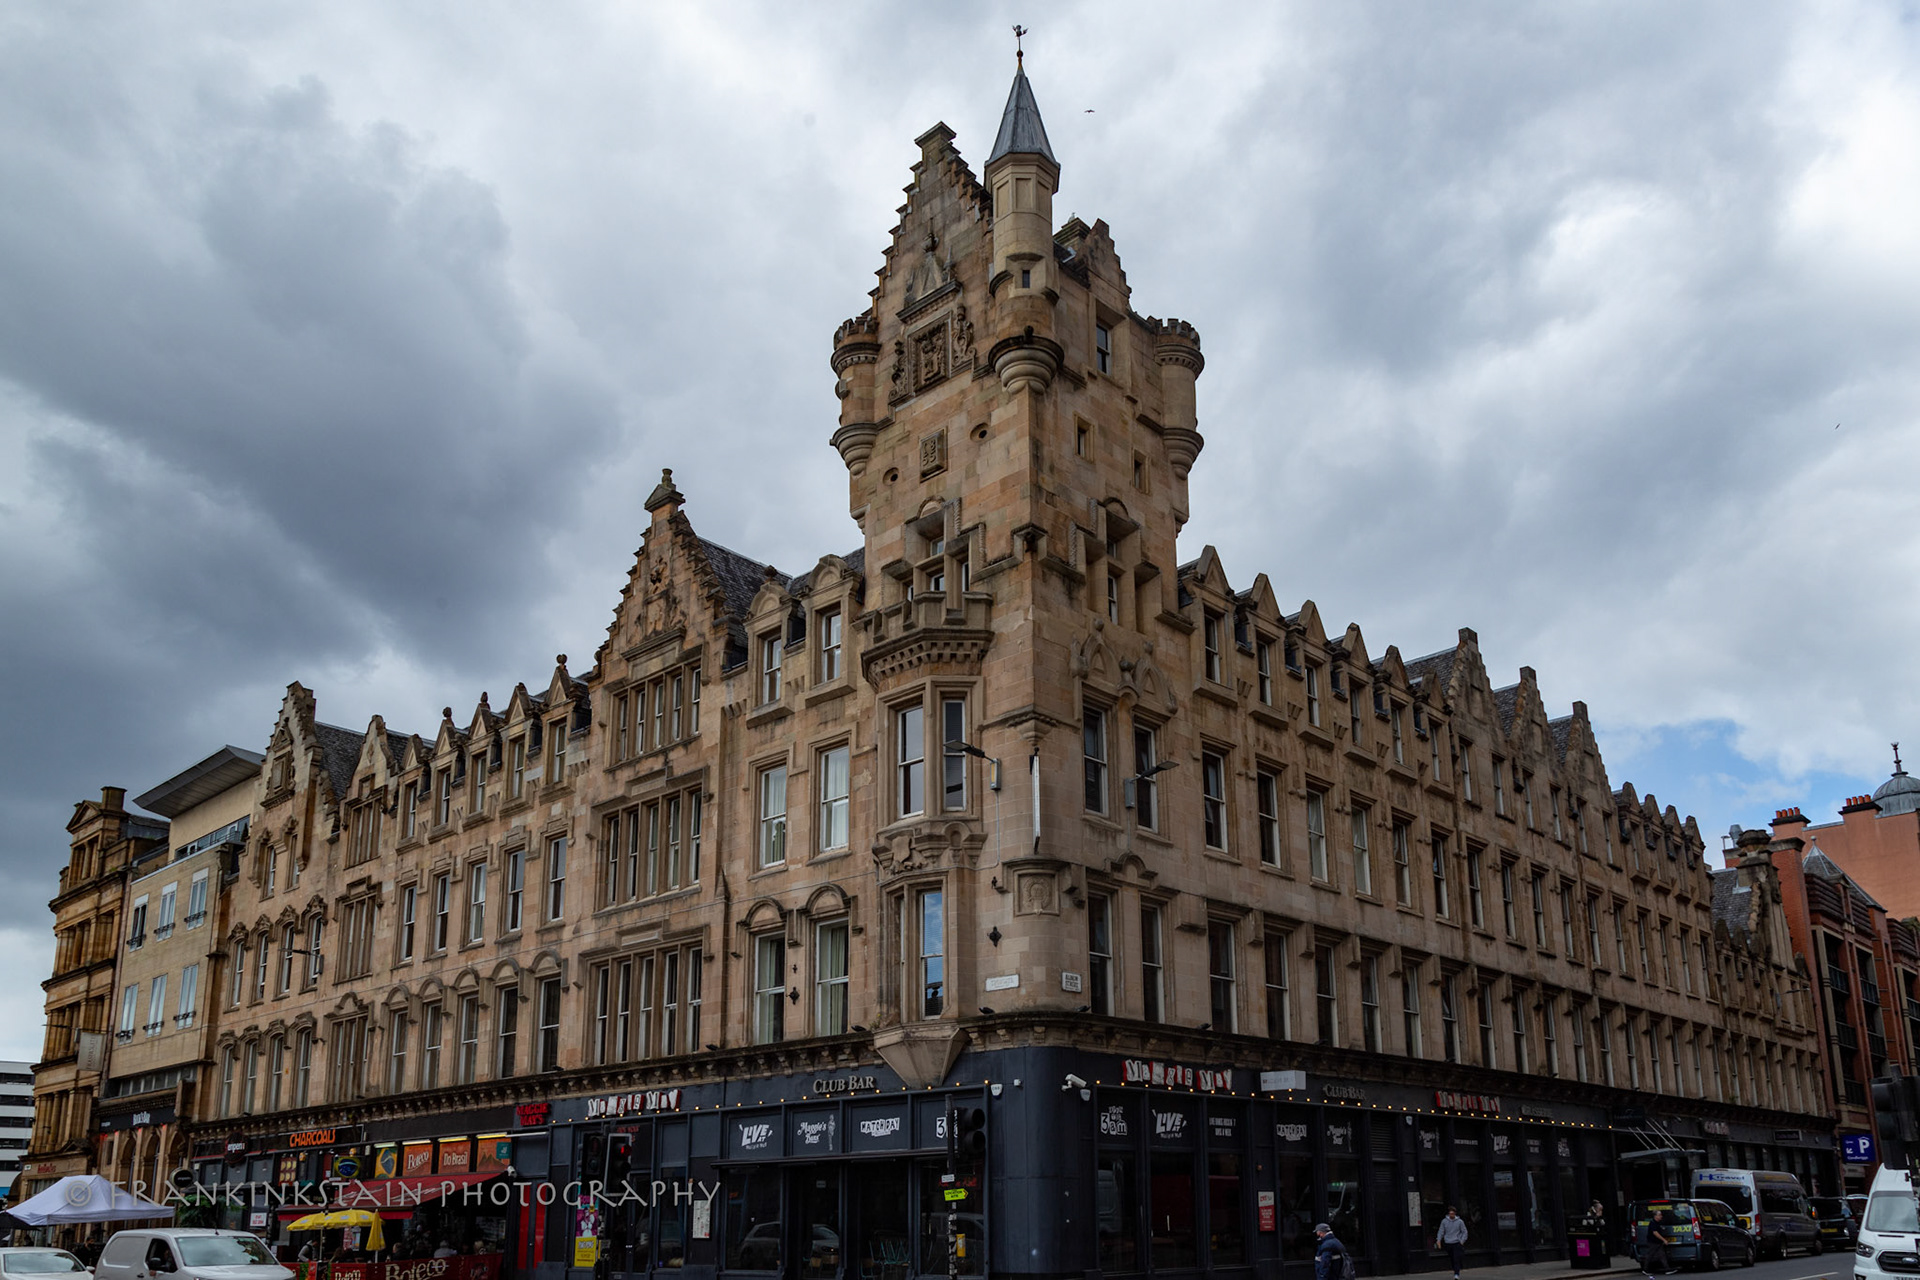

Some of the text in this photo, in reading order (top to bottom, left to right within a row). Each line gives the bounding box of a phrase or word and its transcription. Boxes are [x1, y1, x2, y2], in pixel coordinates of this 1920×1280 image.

[813, 1075, 875, 1093] CLUB BAR
[1324, 1083, 1367, 1100] CLUB BAR
[1156, 1112, 1184, 1134] LIVE
[289, 1129, 336, 1148] CHARCOALS
[742, 1124, 769, 1146] LIVE
[1858, 1136, 1870, 1154] P
[407, 1151, 429, 1170] Boteco
[443, 1151, 468, 1166] Do Brasil
[1672, 1225, 1692, 1233] TAXI
[385, 1258, 446, 1280] Boteco
